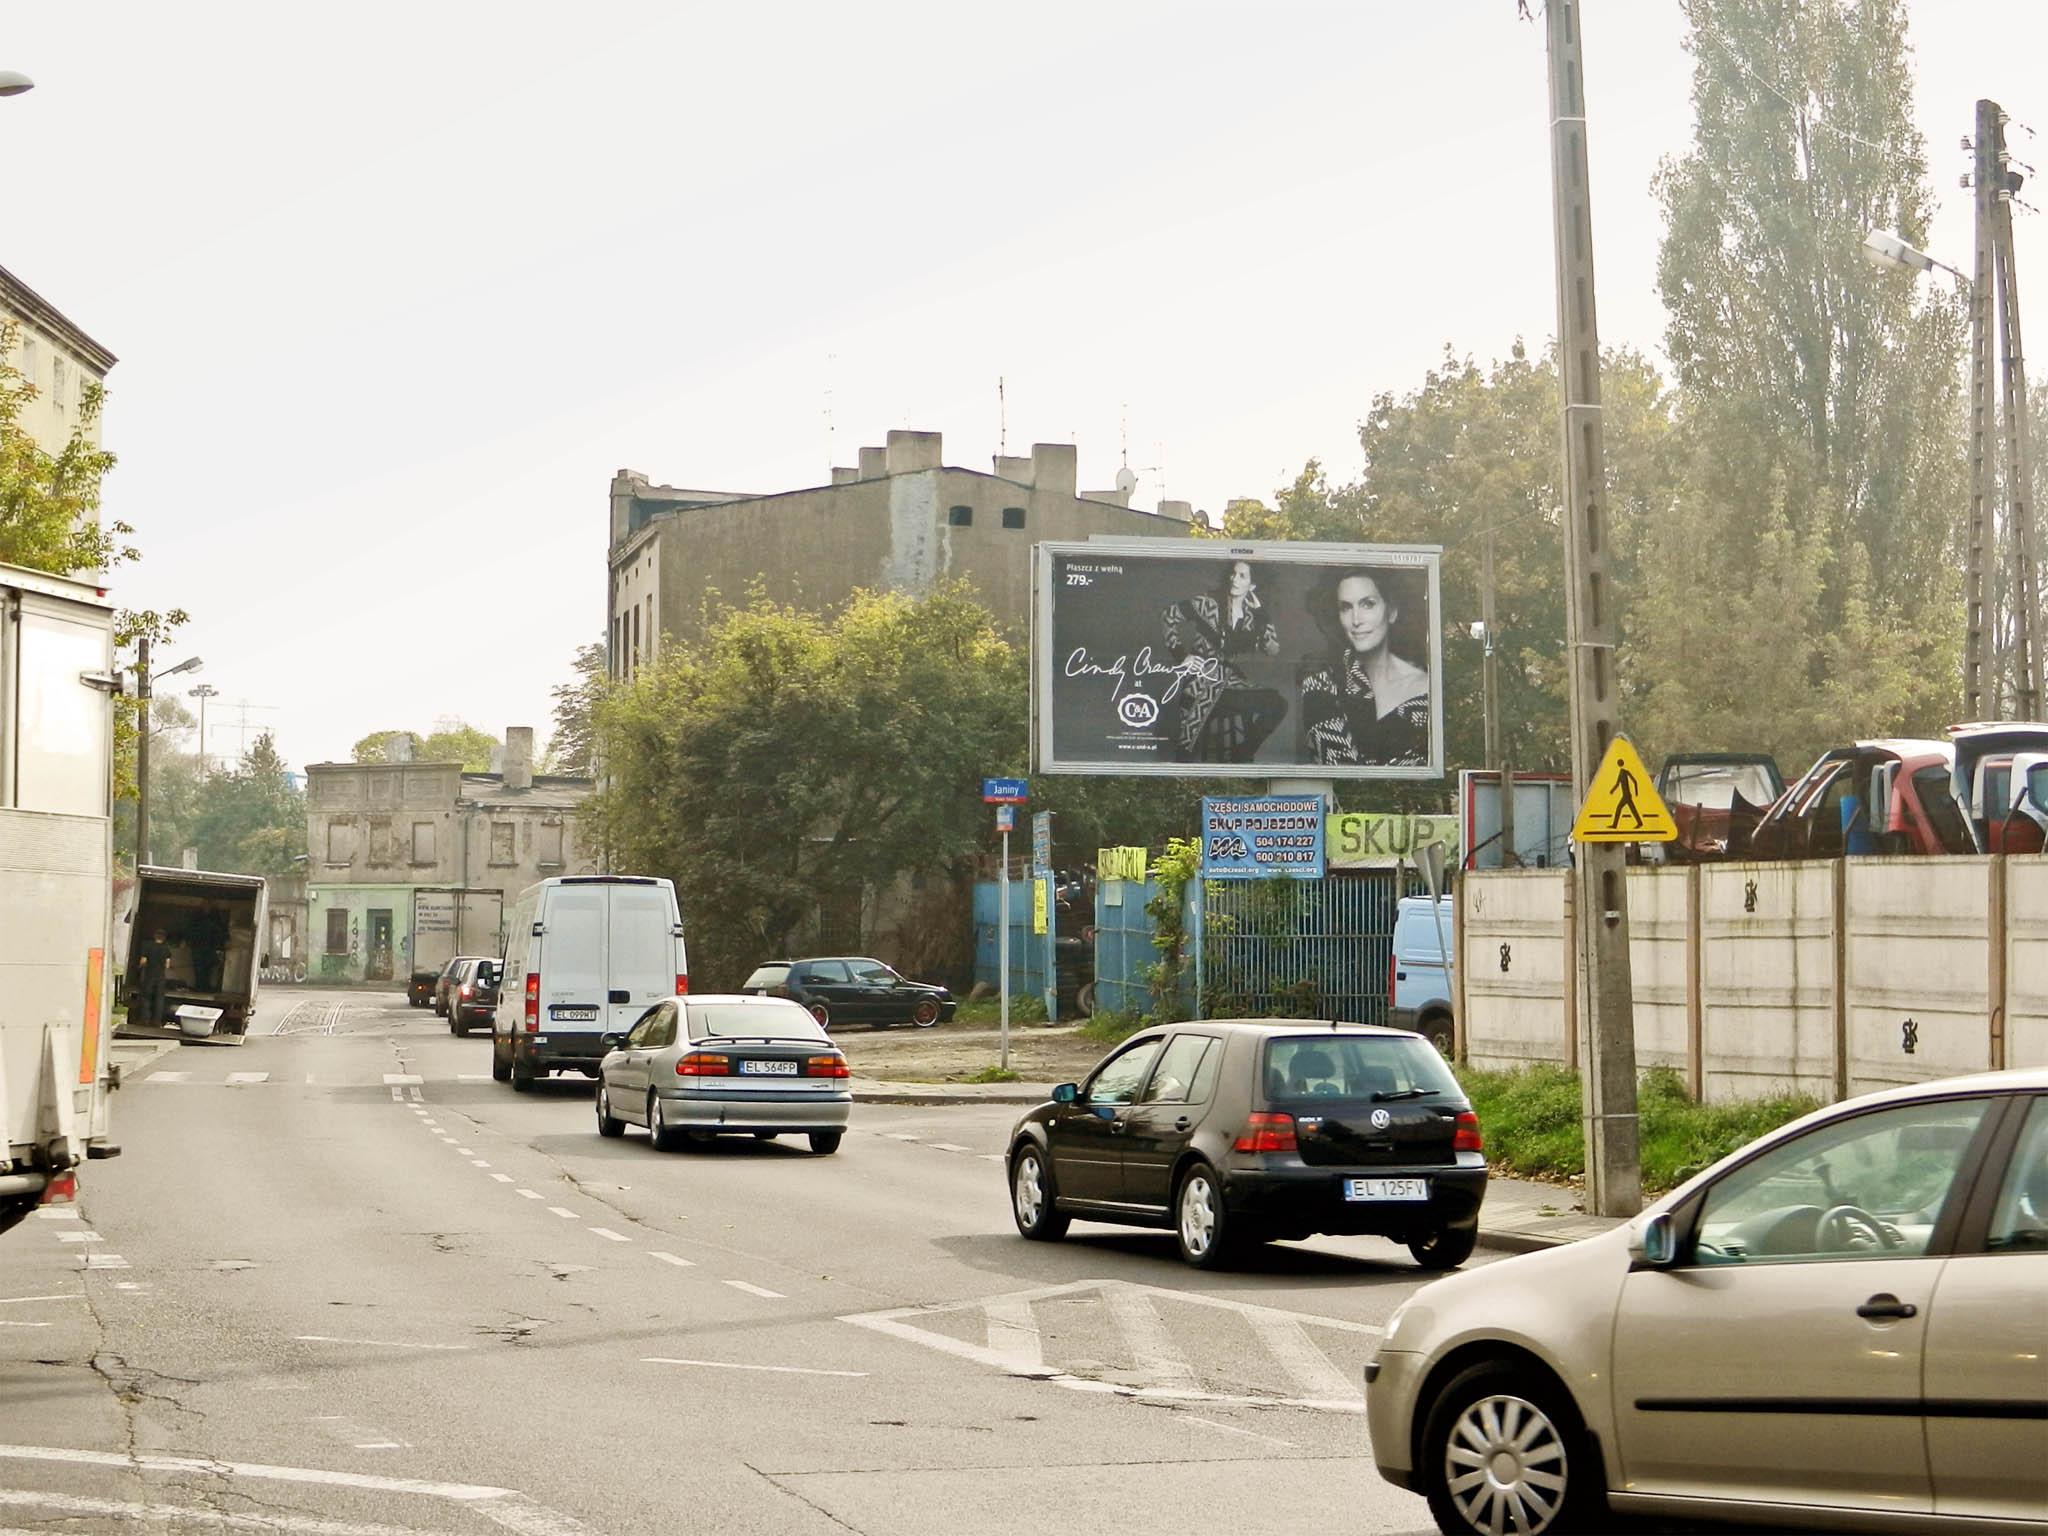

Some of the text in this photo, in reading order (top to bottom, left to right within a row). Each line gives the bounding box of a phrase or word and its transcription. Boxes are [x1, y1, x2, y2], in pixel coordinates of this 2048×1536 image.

[1066, 563, 1093, 573] Płaszcz
[1066, 574, 1093, 585] 279.-
[1065, 646, 1218, 704] Cindy Crawford
[1134, 680, 1142, 688] at
[1124, 702, 1152, 718] C&A
[993, 785, 1019, 797] Janiny
[1209, 801, 1318, 814] CZĘŚCI SAMOCHODOWE
[1209, 817, 1242, 830] SKUP
[1341, 816, 1435, 855] SKUP
[1256, 836, 1314, 847] 504 174 227
[1256, 851, 1314, 862] 600 210 817
[556, 1010, 568, 1019] EL
[746, 1062, 796, 1073] EL 564FP
[1353, 1181, 1424, 1196] EL 125FV
